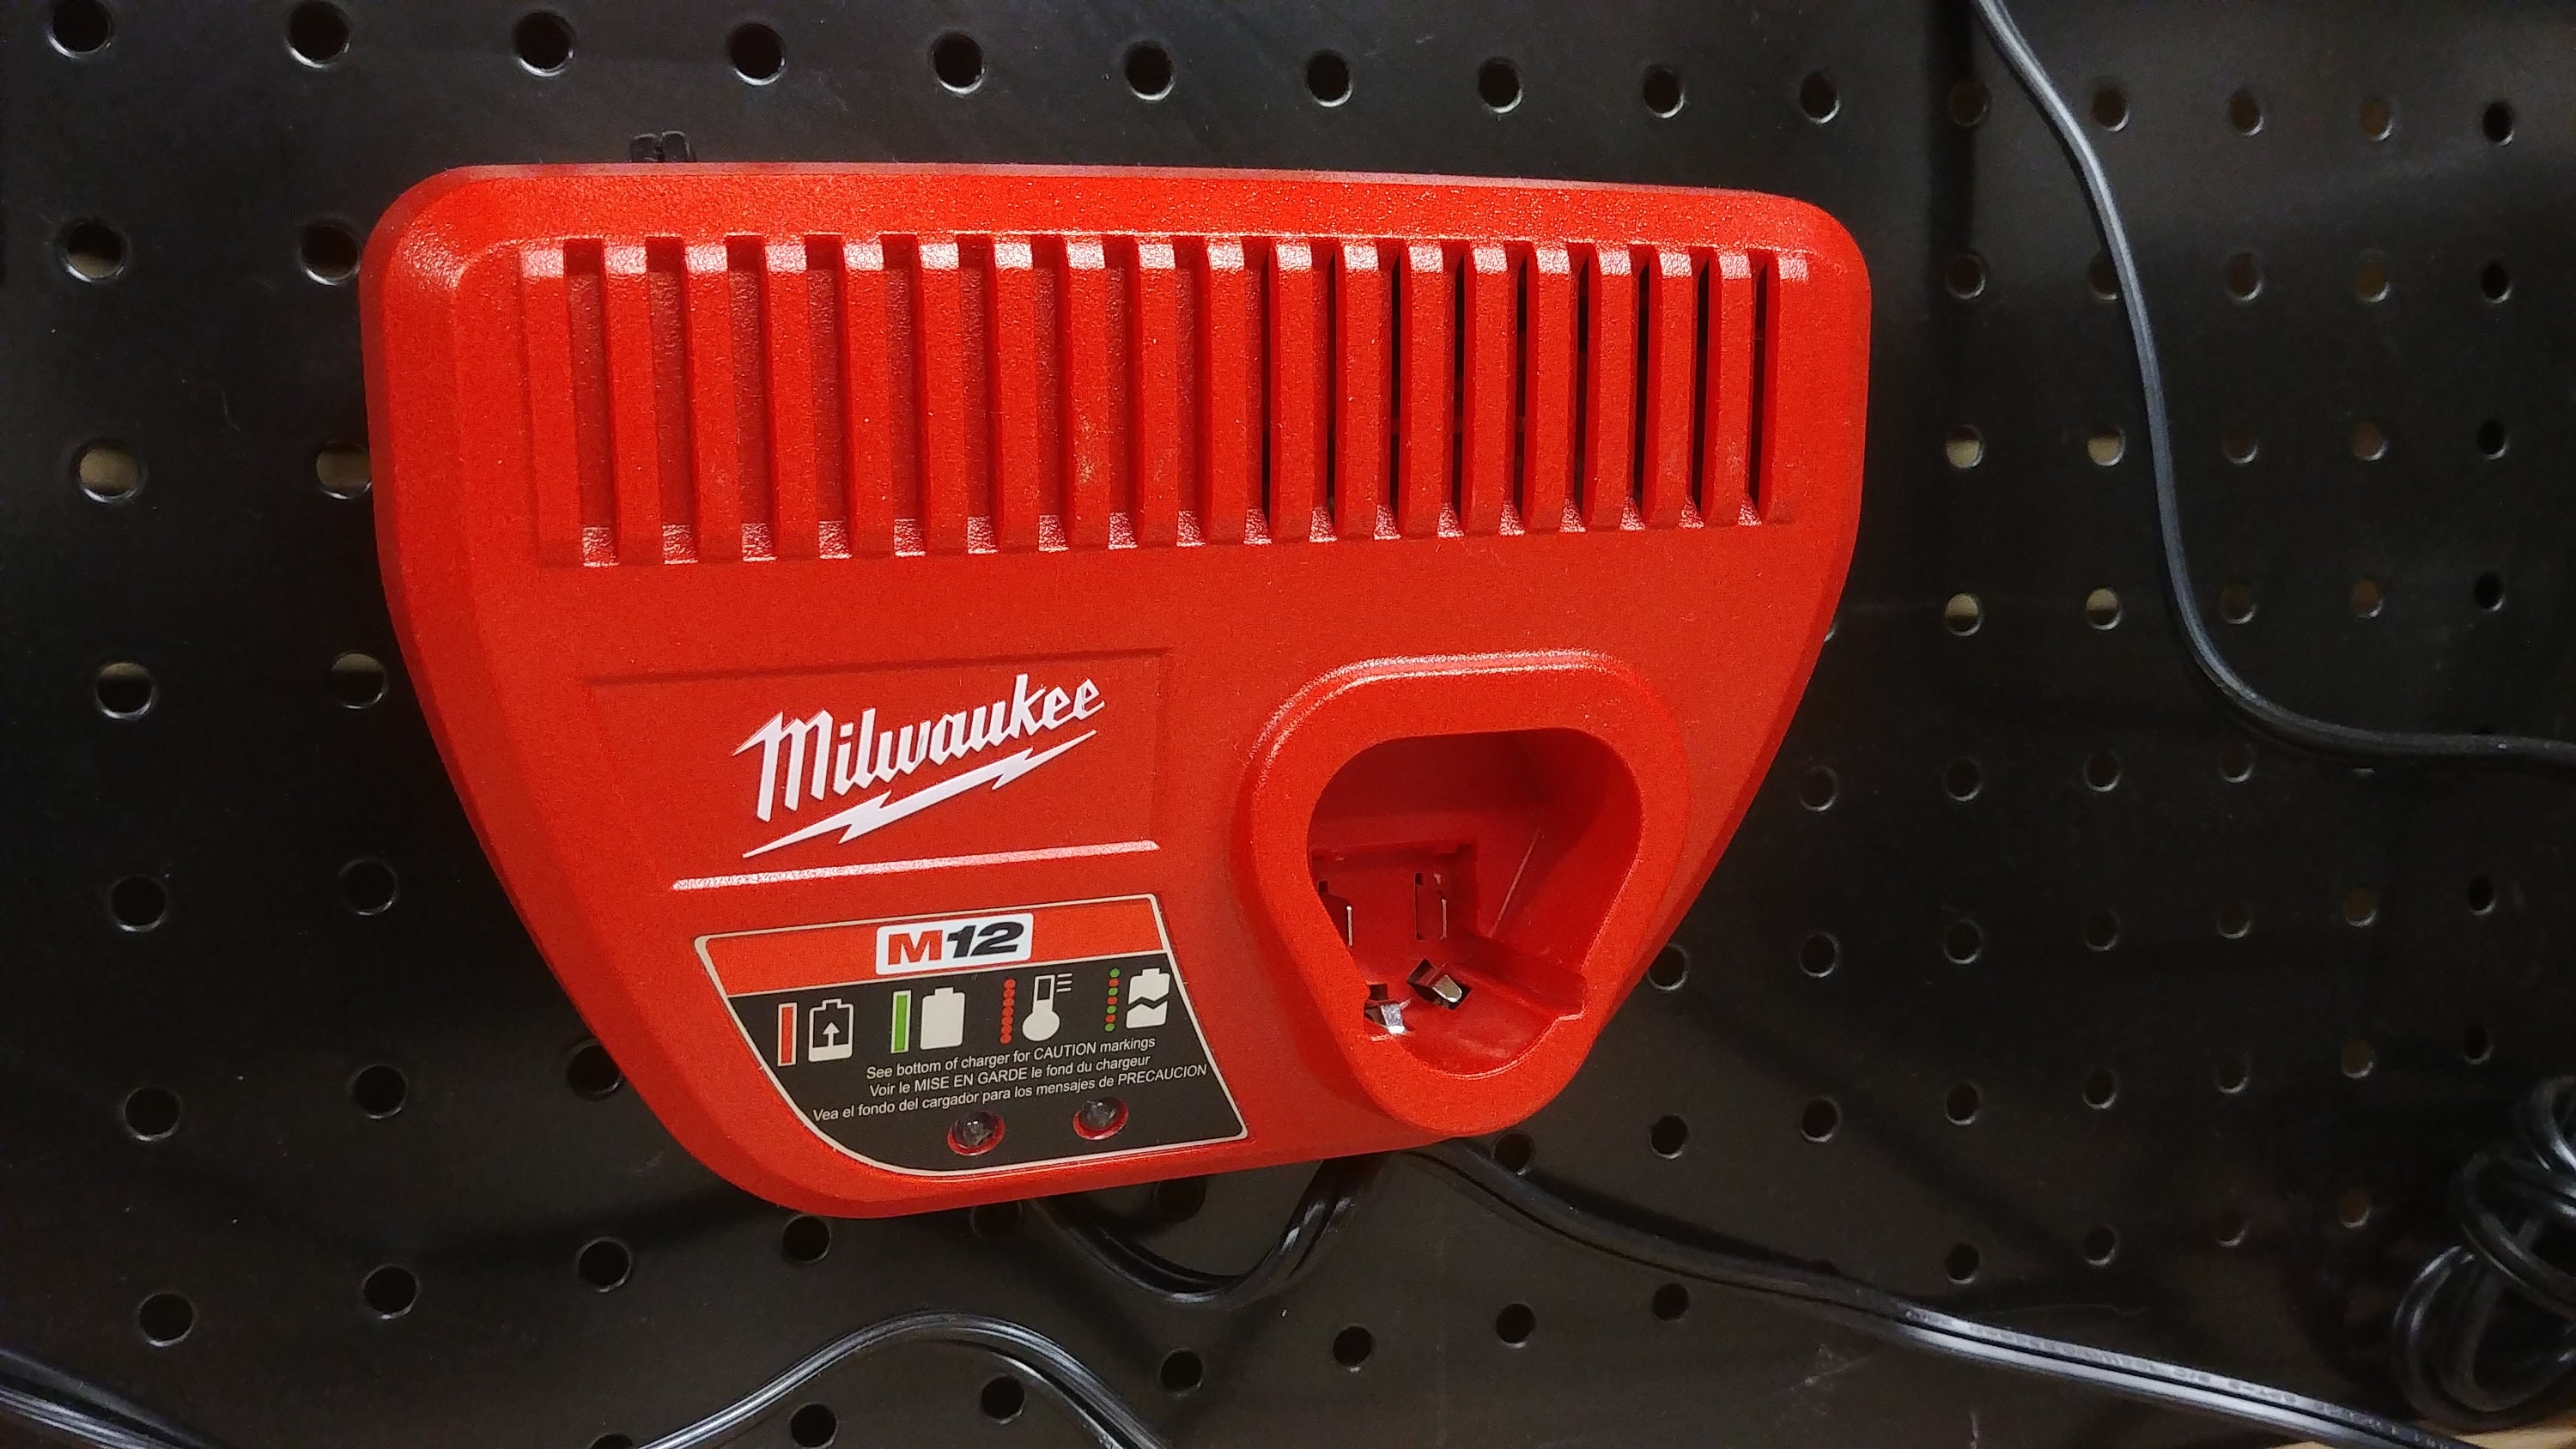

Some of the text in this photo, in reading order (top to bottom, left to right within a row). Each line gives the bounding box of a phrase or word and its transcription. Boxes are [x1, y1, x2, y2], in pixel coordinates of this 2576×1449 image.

[732, 672, 1105, 822] Milwaukee
[888, 921, 1024, 965] M12
[866, 1036, 1156, 1080] See bottom of charger for CAUTION markings
[869, 1054, 1151, 1097] Voir le MISE EN GARDE le fond du chargeur
[812, 1064, 1208, 1122] Vea el fondo del cargador para los mensajes de PRECAUCION
